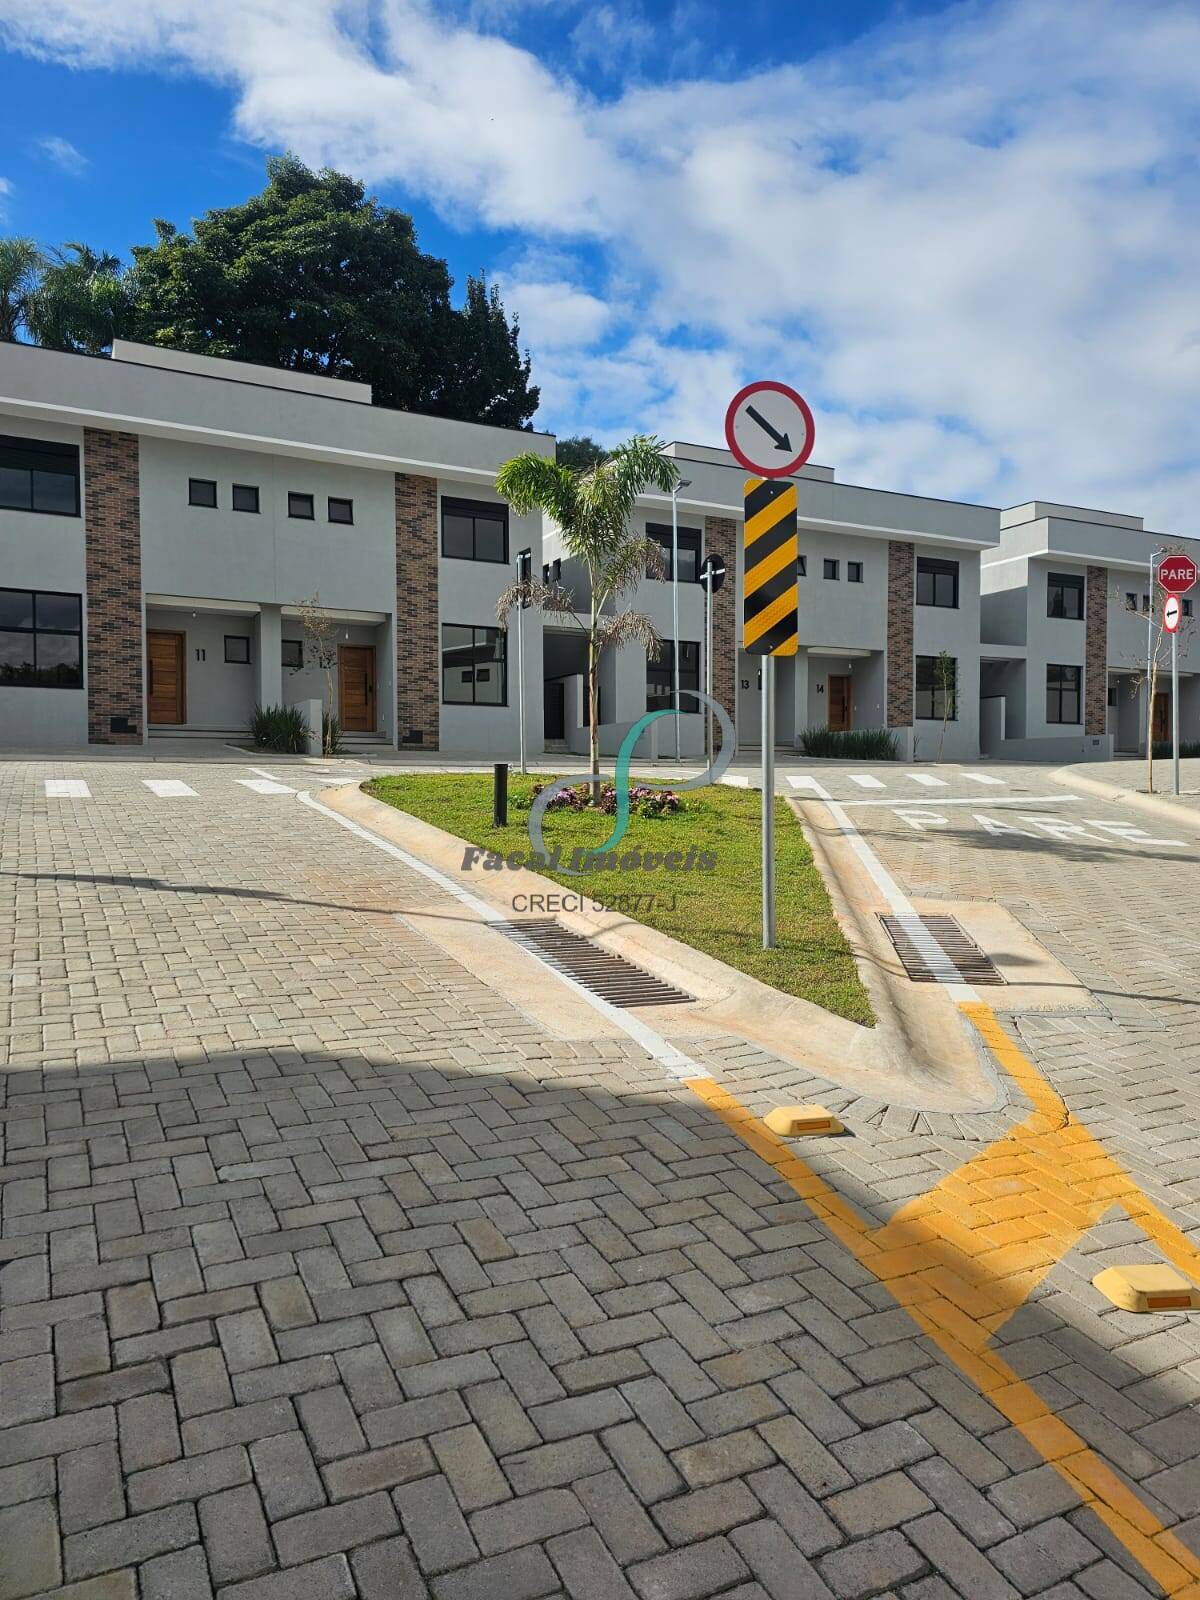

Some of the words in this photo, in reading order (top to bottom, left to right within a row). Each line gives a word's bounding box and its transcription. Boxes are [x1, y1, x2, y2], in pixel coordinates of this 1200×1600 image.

[1160, 569, 1194, 580] PARE
[194, 648, 206, 662] 11
[741, 679, 750, 690] 13
[816, 683, 824, 694] 14
[891, 808, 1190, 847] PARE
